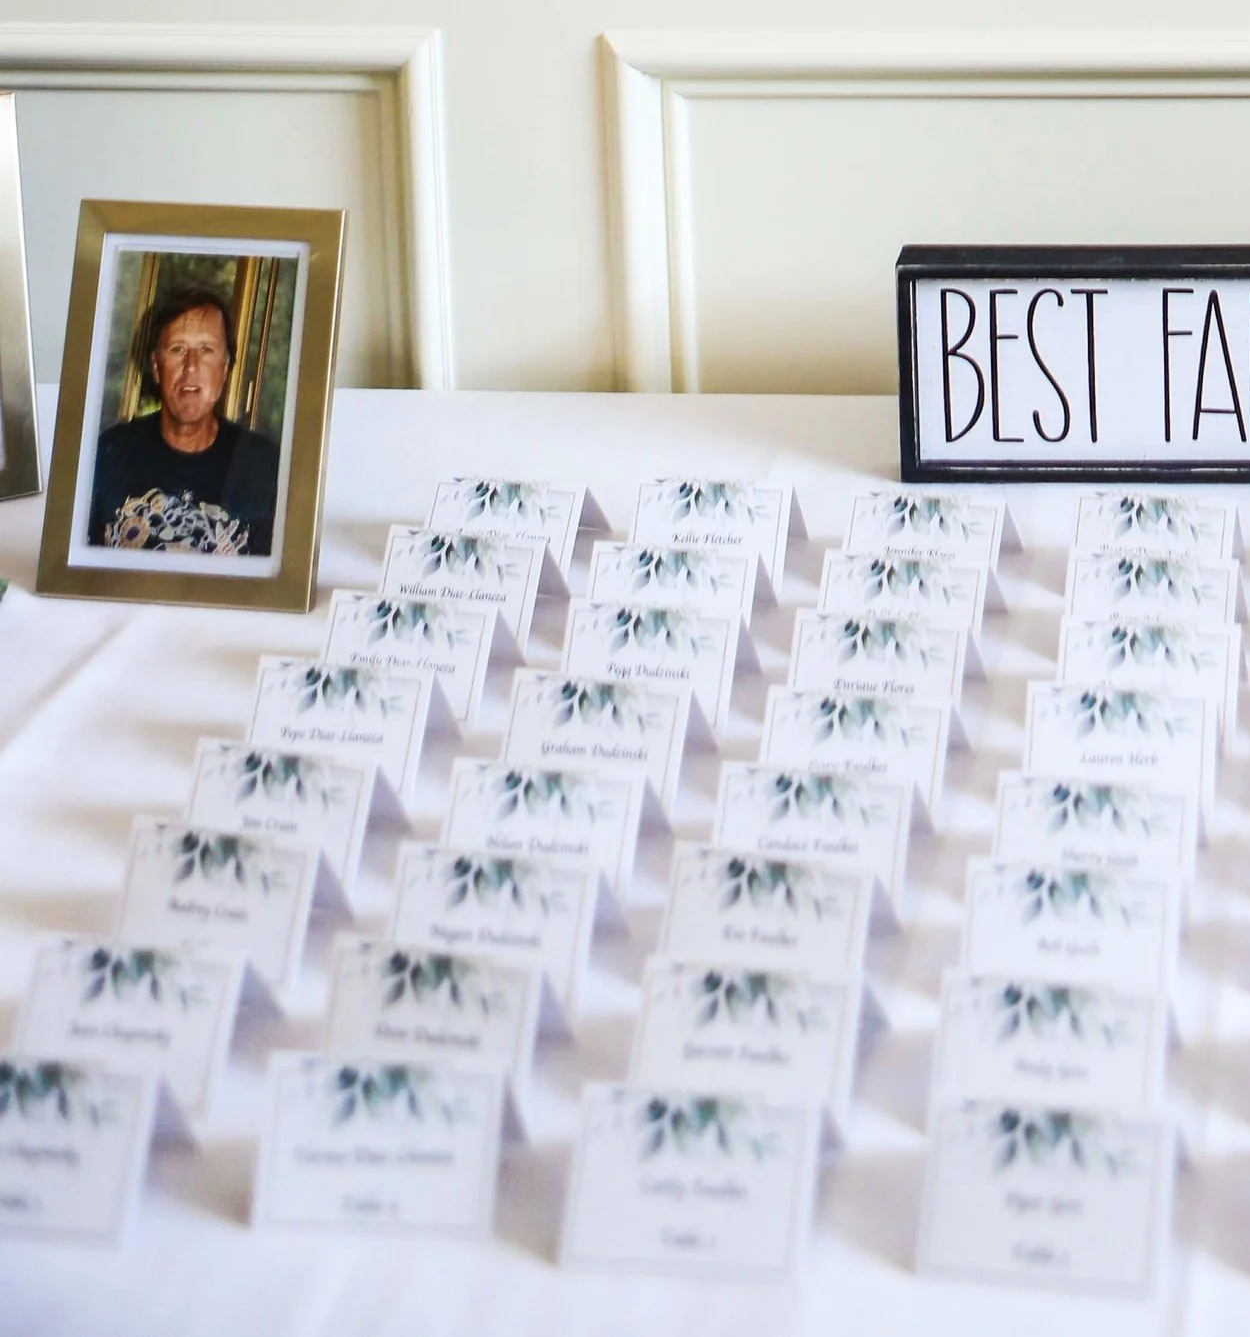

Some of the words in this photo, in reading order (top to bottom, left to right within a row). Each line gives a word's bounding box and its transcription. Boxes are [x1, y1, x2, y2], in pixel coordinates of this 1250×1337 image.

[940, 288, 1108, 443] BEST
[673, 530, 700, 544] Kellie
[704, 532, 744, 546] Fletcher
[400, 583, 438, 598] William
